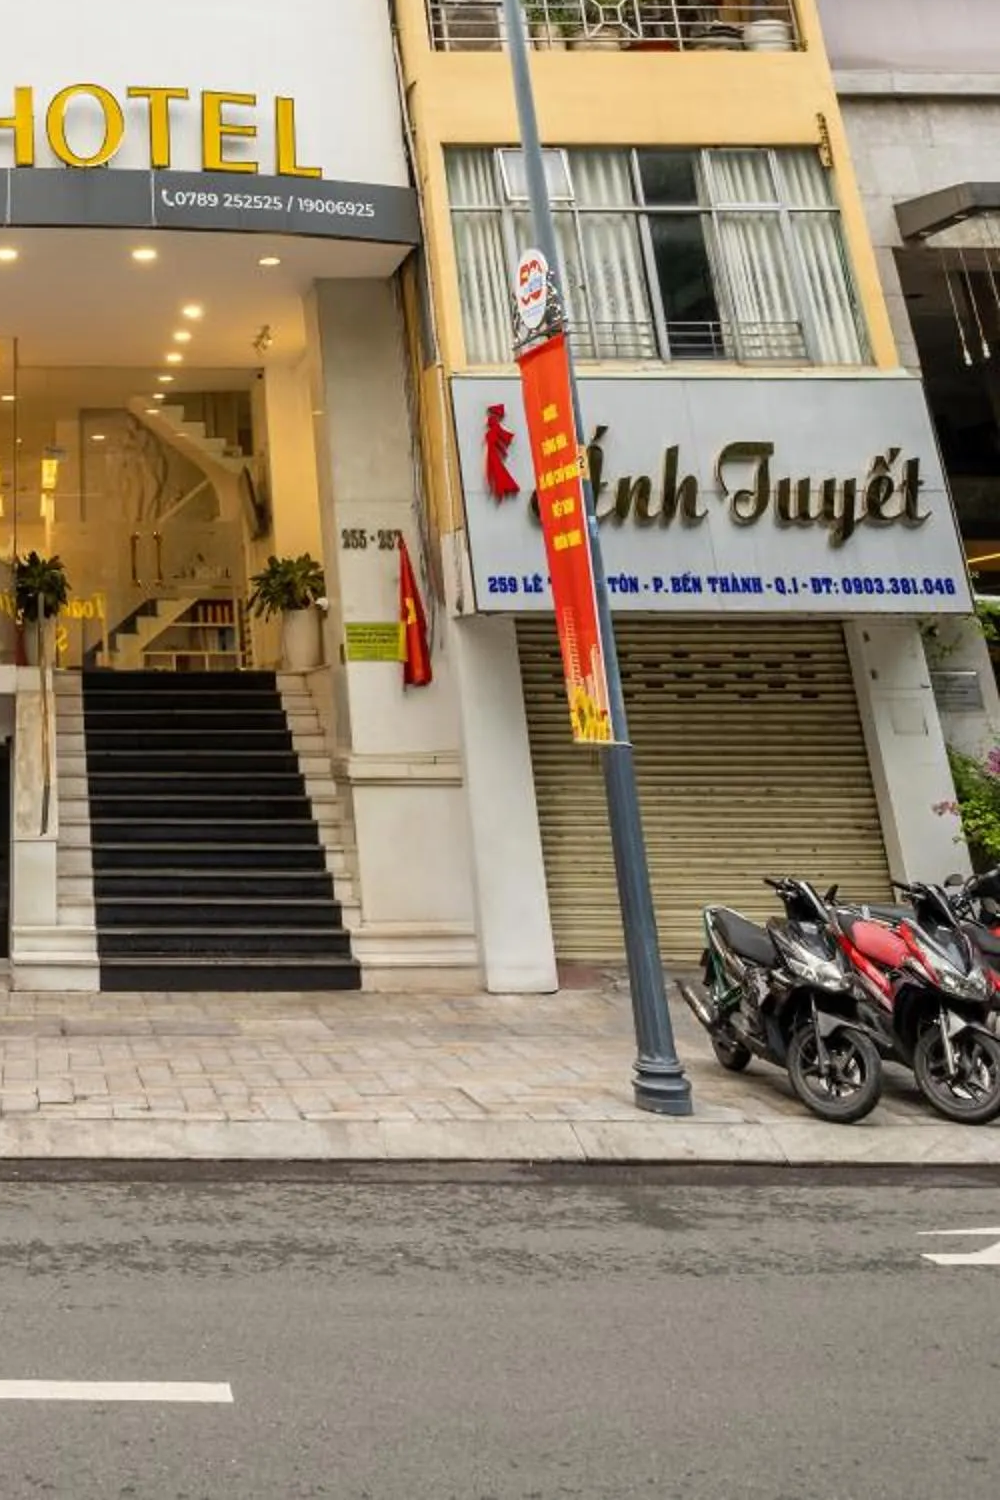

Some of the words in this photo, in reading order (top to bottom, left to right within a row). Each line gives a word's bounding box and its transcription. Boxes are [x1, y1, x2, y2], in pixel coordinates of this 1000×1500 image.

[174, 191, 218, 208] 0789
[223, 195, 283, 211] 252525
[297, 197, 376, 217] 19006925
[714, 441, 932, 548] Tuyết
[341, 529, 367, 550] 255
[487, 576, 519, 594] 259
[523, 571, 543, 594] LÊ
[607, 573, 639, 594] TÔN
[707, 572, 763, 594] THÀNH
